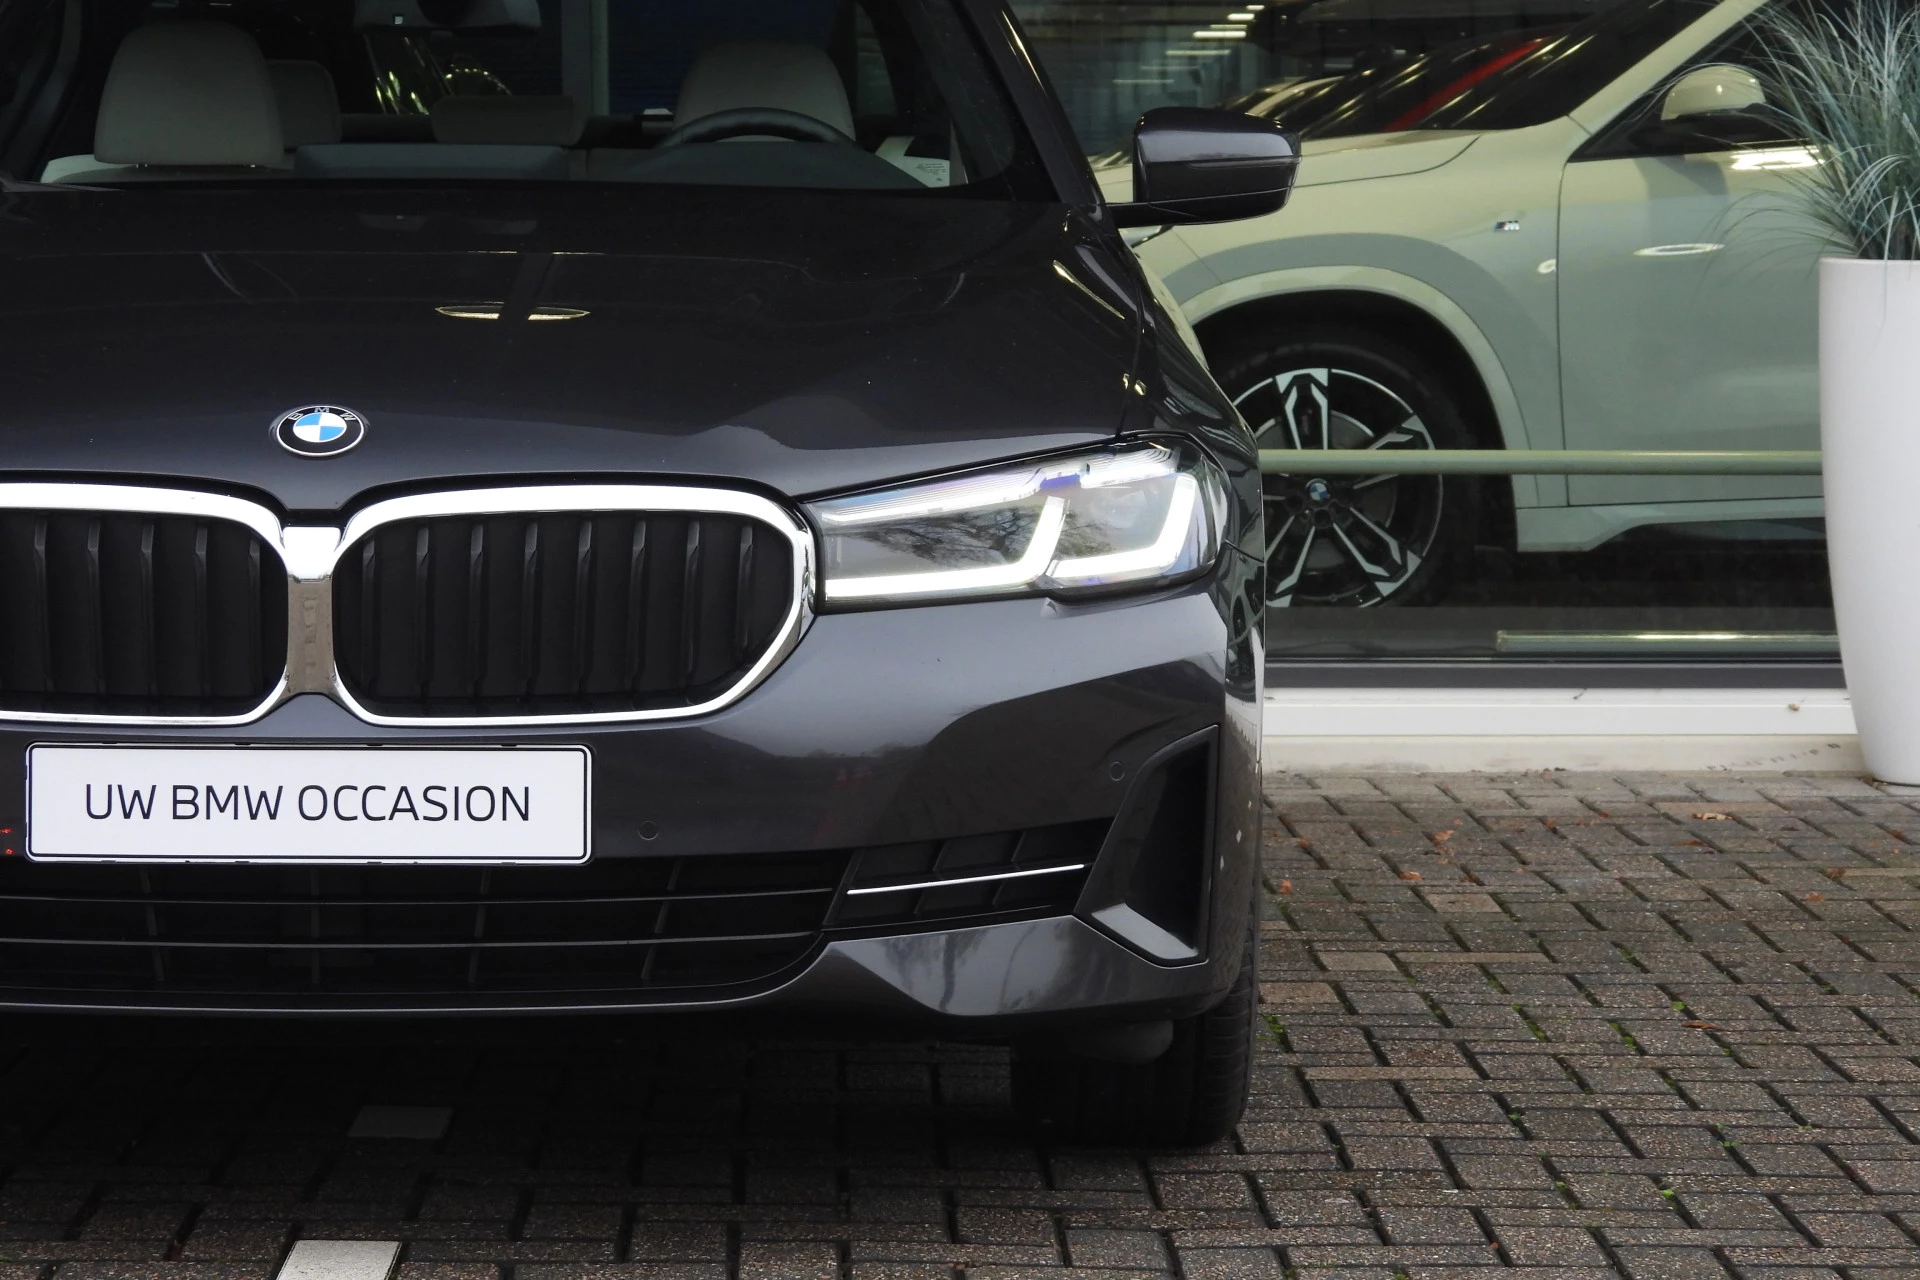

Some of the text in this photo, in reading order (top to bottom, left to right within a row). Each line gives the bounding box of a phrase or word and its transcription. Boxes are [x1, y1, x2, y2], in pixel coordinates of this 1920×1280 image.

[288, 407, 357, 421] BMW
[86, 783, 530, 822] UW BMW OCCASION
